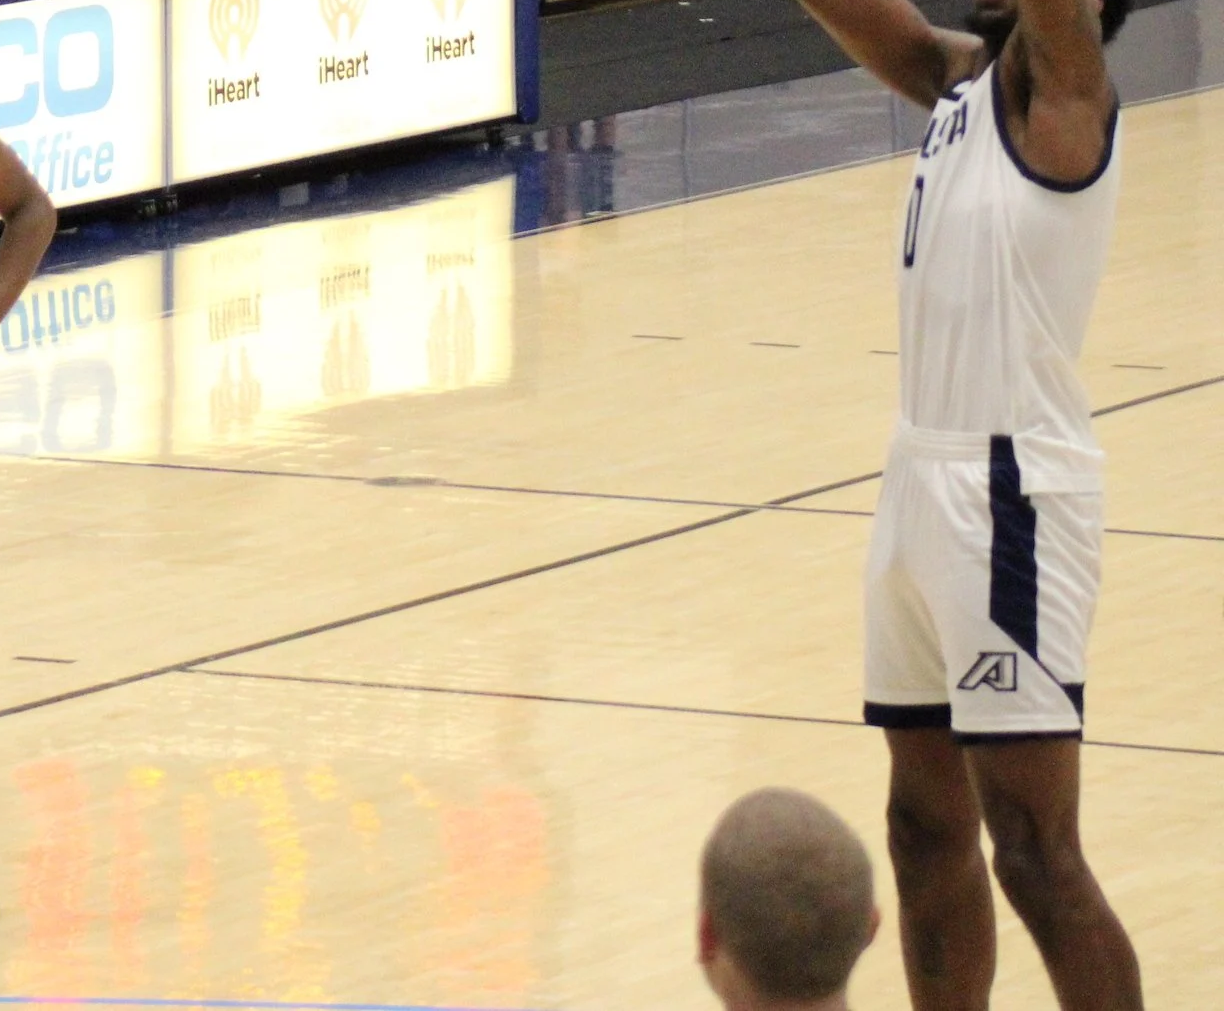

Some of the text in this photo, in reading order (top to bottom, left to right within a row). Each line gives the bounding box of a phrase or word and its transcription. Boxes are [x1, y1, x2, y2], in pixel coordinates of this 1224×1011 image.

[425, 30, 475, 64] iHeart
[318, 50, 369, 85] iHeart
[208, 71, 261, 107] iHeart
[956, 650, 1018, 692] A
